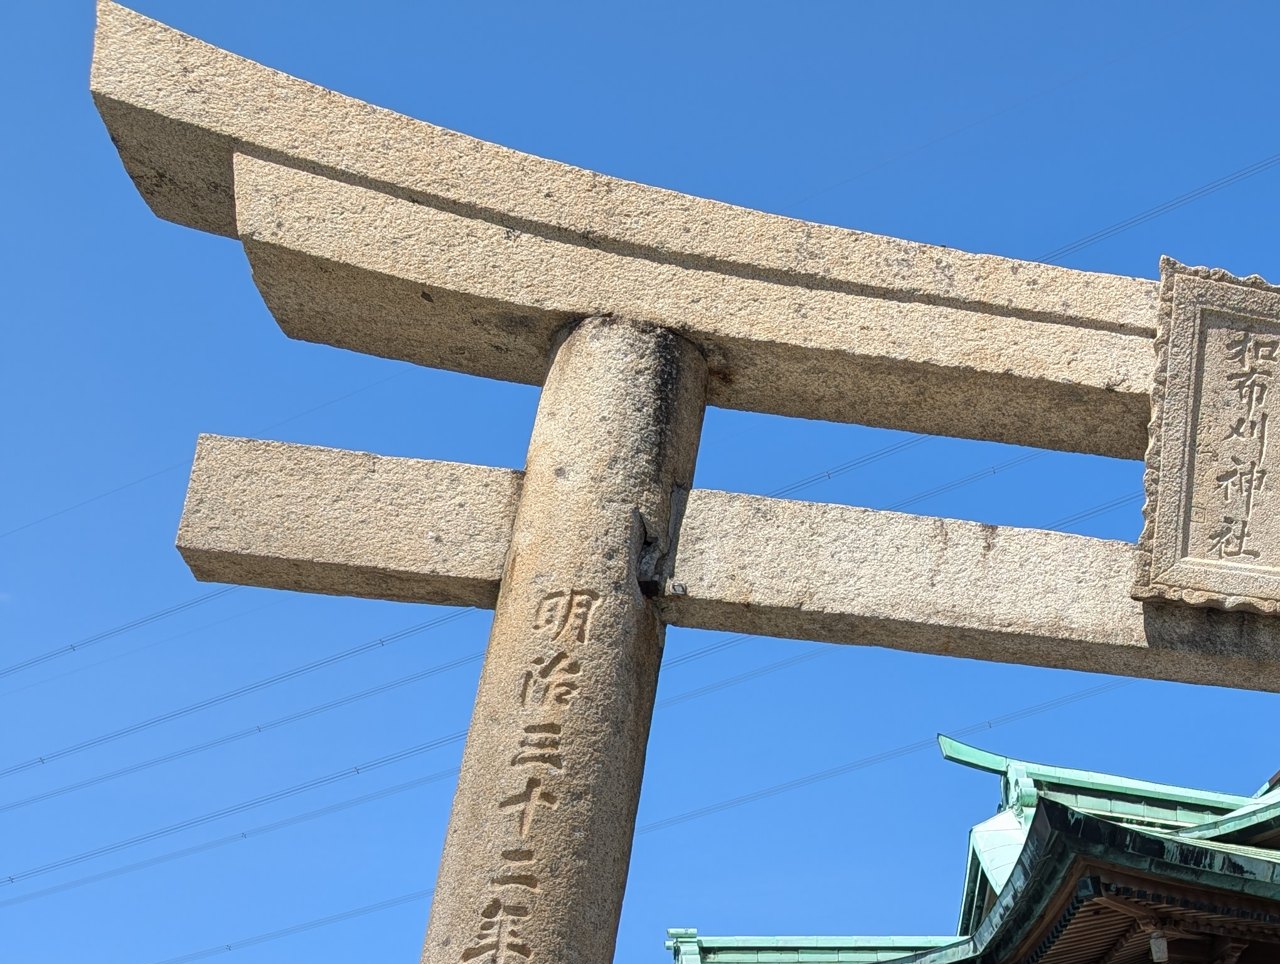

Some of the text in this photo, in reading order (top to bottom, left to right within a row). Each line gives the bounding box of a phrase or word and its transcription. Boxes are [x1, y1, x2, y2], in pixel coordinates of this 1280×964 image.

[1208, 332, 1280, 560] 和布刈神社
